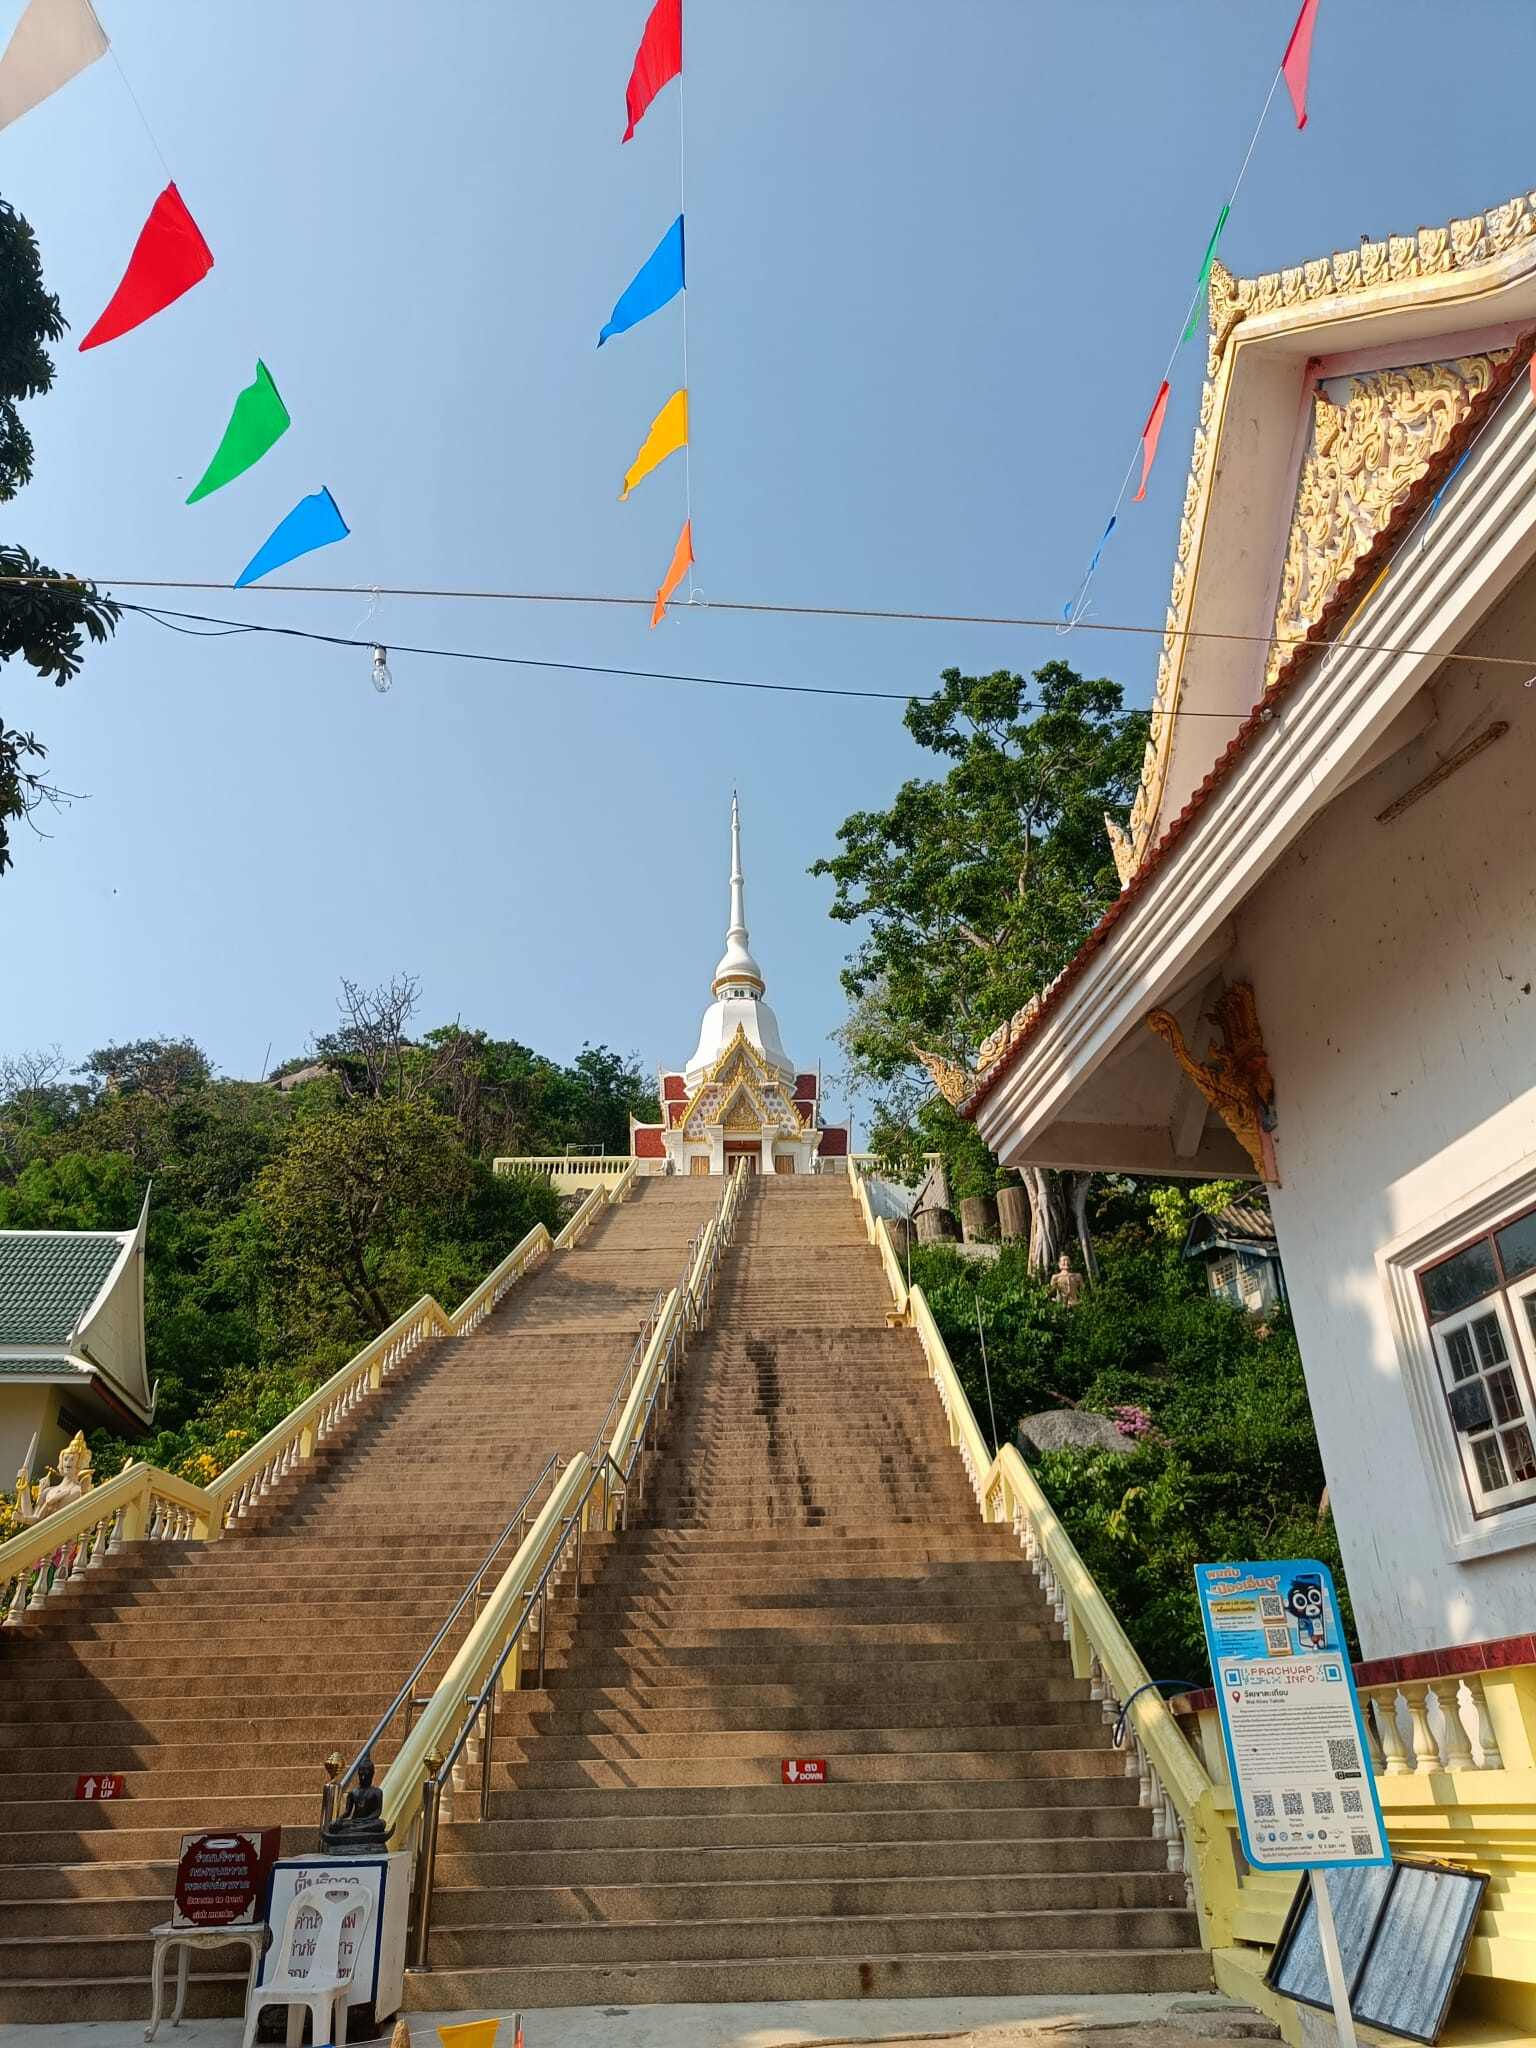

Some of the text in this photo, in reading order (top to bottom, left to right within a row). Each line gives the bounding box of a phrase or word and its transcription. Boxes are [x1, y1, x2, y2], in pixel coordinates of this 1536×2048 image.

[1251, 1665, 1312, 1676] PRACHUAP
[1286, 1675, 1315, 1684] INFO
[800, 1772, 823, 1780] DOWN
[100, 1790, 113, 1798] UP
